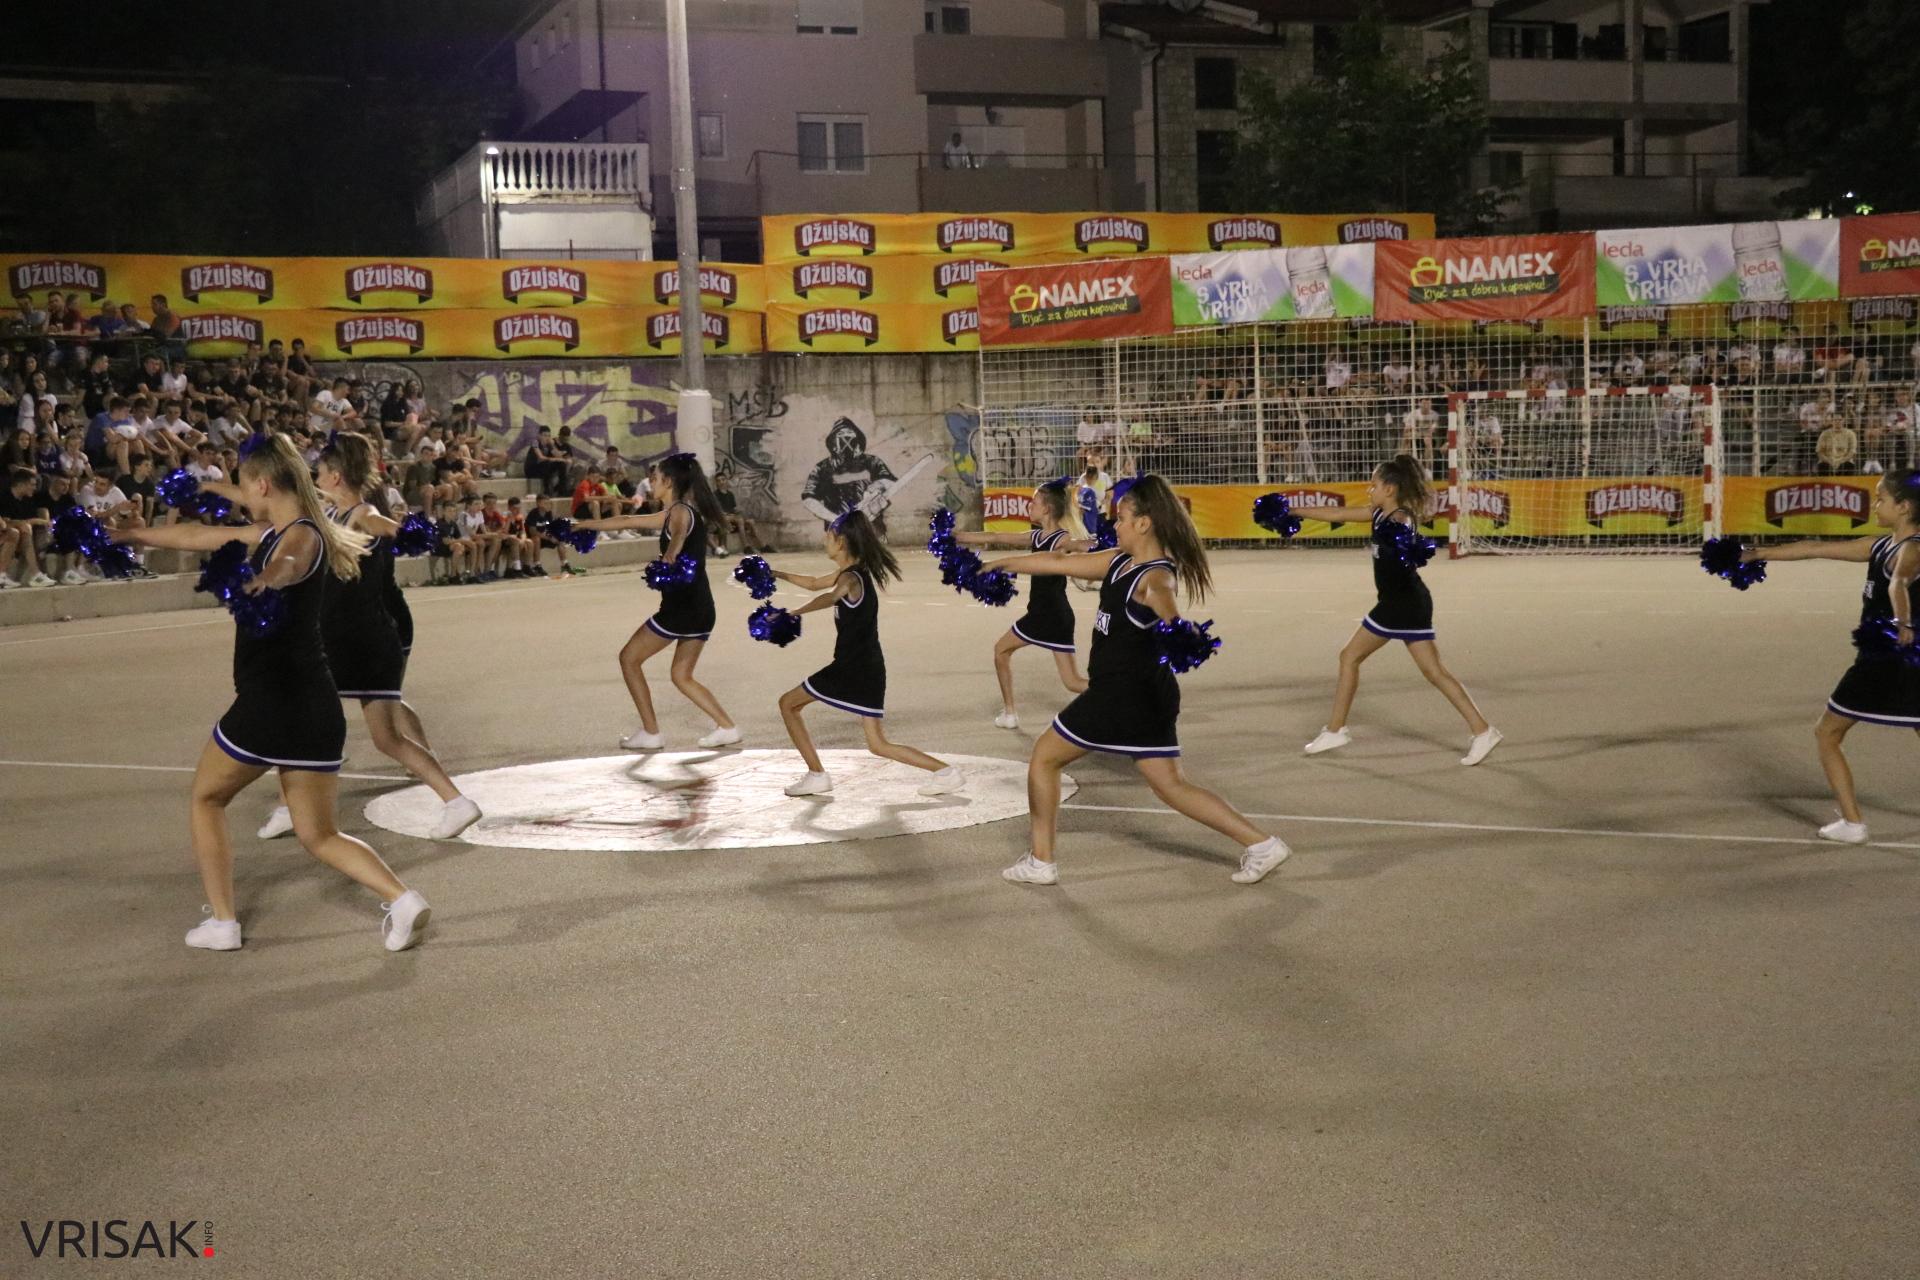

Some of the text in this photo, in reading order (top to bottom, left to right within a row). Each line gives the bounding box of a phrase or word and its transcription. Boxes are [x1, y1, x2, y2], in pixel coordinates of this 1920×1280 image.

[802, 220, 869, 246] Ožujsko
[944, 219, 1008, 243] Ožujsko
[1081, 218, 1143, 243] Ožujsko
[1214, 218, 1275, 243] Ožujsko
[1344, 220, 1403, 242] Ožujsko
[1603, 241, 1644, 258] leda
[18, 262, 98, 289] Ožujsko
[190, 264, 266, 291] Ožujsko
[353, 264, 427, 291] Ožujsko
[510, 266, 580, 291] Ožujsko
[801, 262, 867, 287] Ožujsko
[1177, 266, 1212, 281] leda
[1445, 252, 1556, 284] NAMEX
[1743, 259, 1778, 277] leda
[662, 271, 731, 294] Ožsko
[1040, 275, 1136, 309] NAMEX
[1296, 280, 1326, 296] leda
[181, 315, 256, 341] Ožujsko
[343, 316, 418, 342] Ožujsko
[501, 317, 572, 341] Ožujsko
[654, 313, 722, 337] Ožuko
[805, 309, 872, 334] Ožujsko
[984, 494, 1030, 518] žujsk
[1424, 489, 1502, 515] Ožsko
[1594, 485, 1676, 514] Ožujsko
[1775, 485, 1861, 513] Ožujsko
